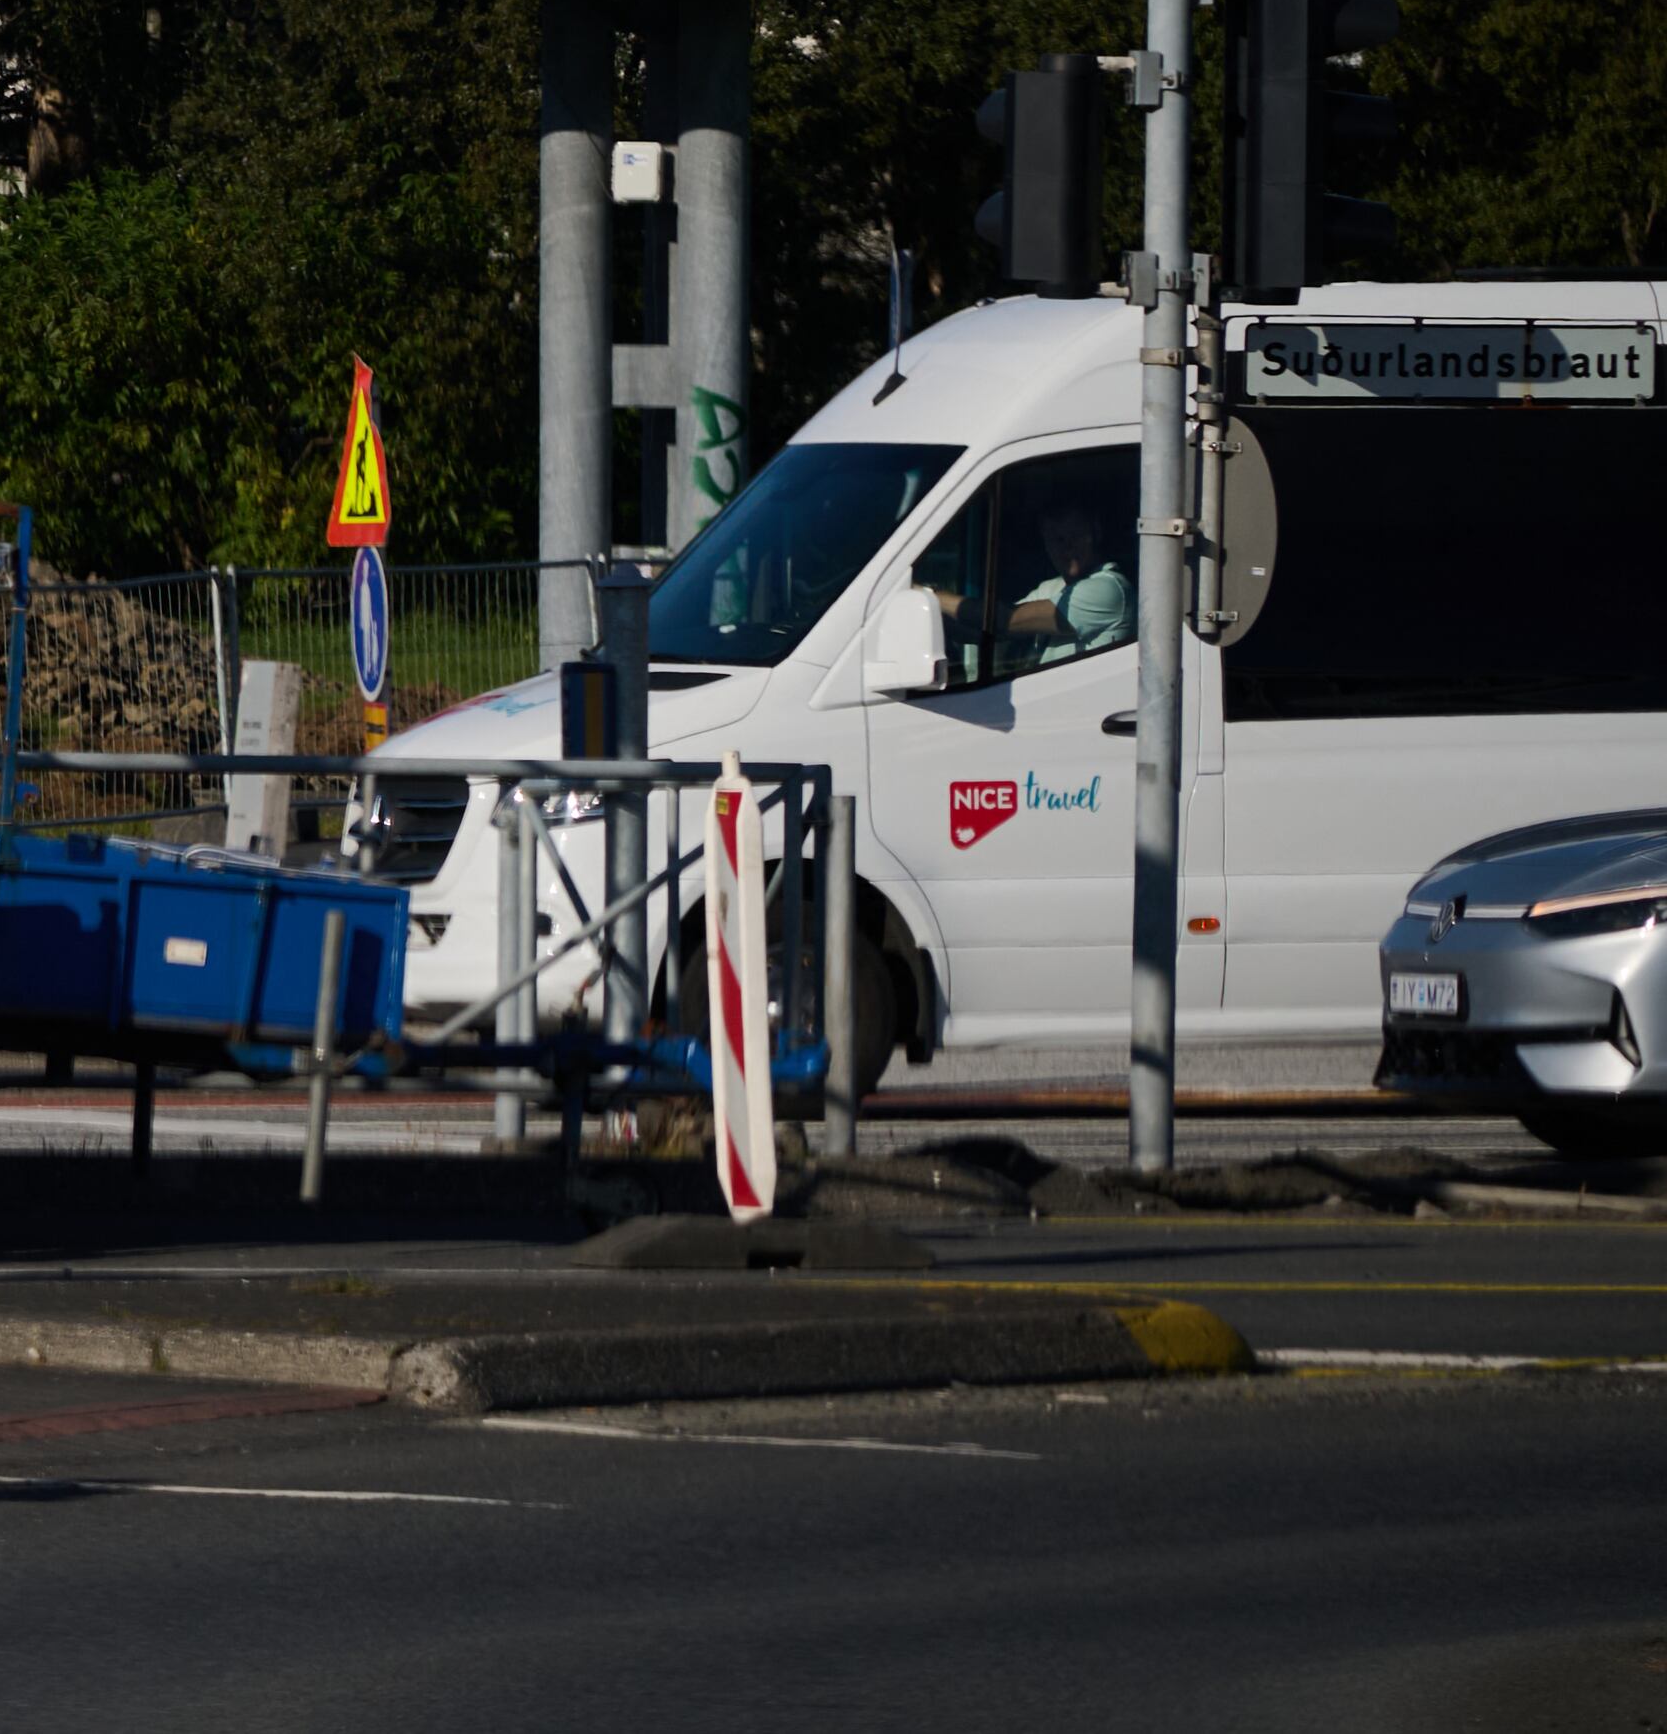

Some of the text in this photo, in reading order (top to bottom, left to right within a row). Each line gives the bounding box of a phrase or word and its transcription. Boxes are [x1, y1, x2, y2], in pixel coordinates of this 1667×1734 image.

[1261, 342, 1641, 379] Suðurlandsbraut
[953, 770, 1102, 813] NICE travel
